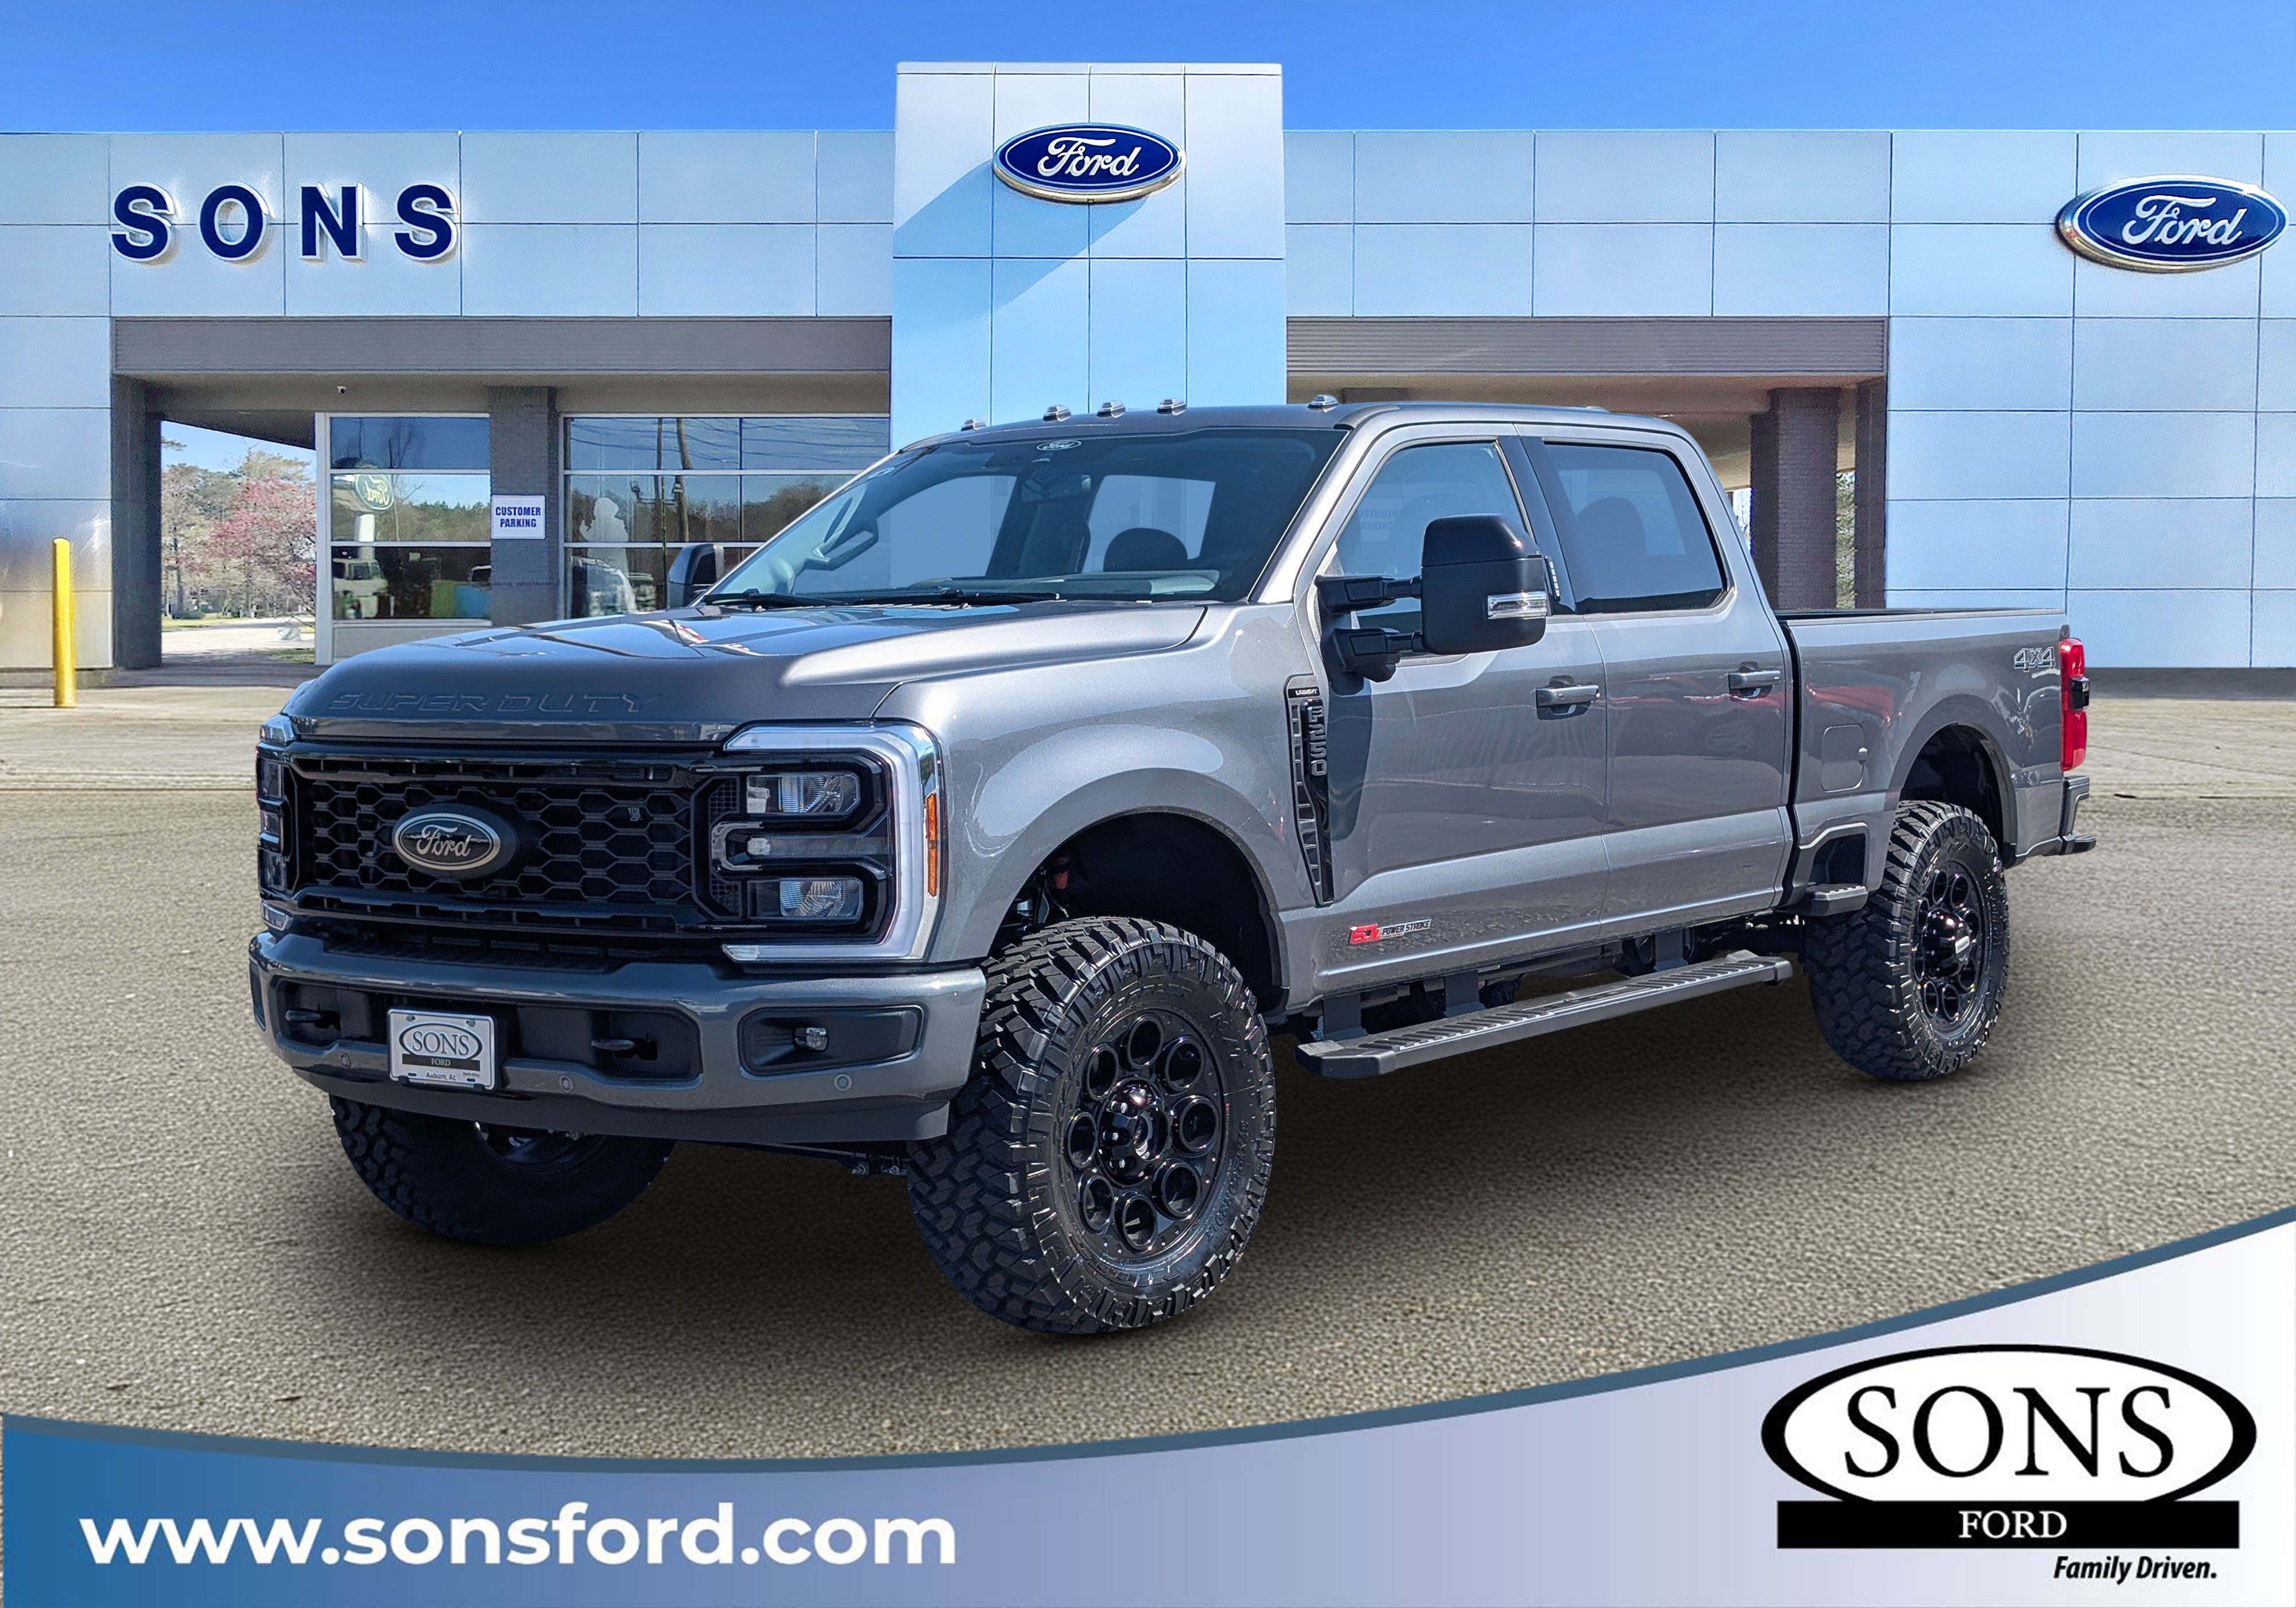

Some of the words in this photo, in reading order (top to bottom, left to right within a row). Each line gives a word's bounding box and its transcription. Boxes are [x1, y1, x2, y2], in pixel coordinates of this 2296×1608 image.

[1037, 136, 1142, 177] Ford
[111, 183, 459, 261] SONS
[2122, 195, 2247, 245] Ford
[495, 507, 541, 516] CUSTOMER
[500, 519, 536, 527] PARKING
[329, 692, 492, 712] SUPER
[497, 692, 662, 712] DUTY
[417, 824, 472, 857] Ford
[1382, 925, 1405, 935] POWER
[1405, 920, 1430, 932] STROKE
[412, 1031, 470, 1056] SONS
[431, 1058, 451, 1067] FORD
